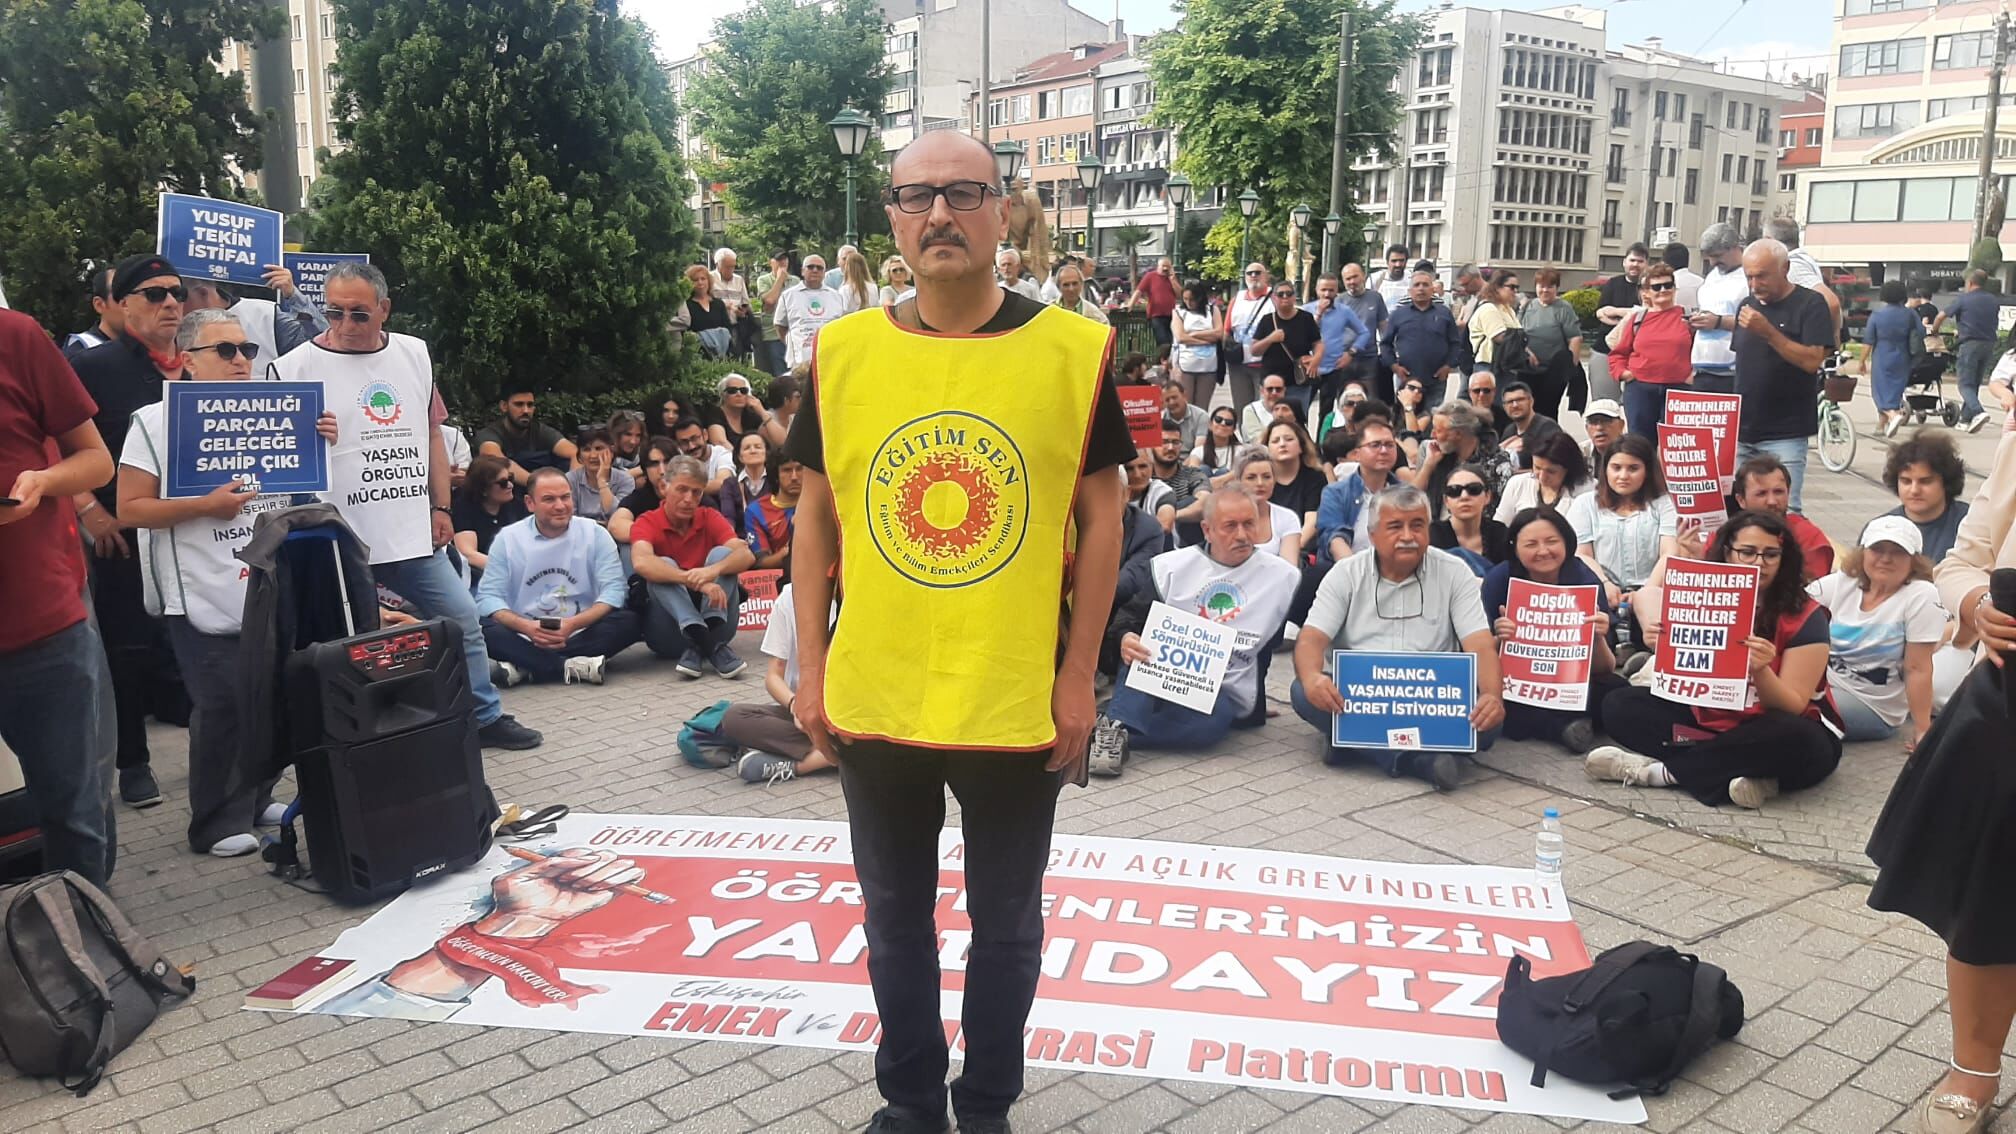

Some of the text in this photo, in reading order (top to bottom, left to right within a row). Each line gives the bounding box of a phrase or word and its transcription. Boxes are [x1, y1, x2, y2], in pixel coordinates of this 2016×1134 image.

[192, 208, 255, 230] YUSUF
[194, 226, 252, 247] TEKİN
[188, 239, 256, 265] İSTİFA!
[209, 264, 228, 275] SOL
[197, 395, 301, 414] KARANLIĞI
[1668, 399, 1736, 412] ÖĞRETMENLERE
[204, 417, 294, 435] PARÇALA
[200, 432, 296, 452] GELECEĞE
[1667, 433, 1696, 450] DÜŞÜK
[196, 452, 300, 473] SAHİP ÇIK!
[362, 446, 419, 464] YAŞASIN
[876, 425, 1020, 487] EĞİTİM SEN
[232, 473, 260, 484] SOL
[362, 462, 426, 482] ÖRGÜTLÜ
[880, 504, 1014, 576] Eğitim ve Bilim Emekçileri Sendikası
[1666, 568, 1754, 588] ÖĞRETMENLERE
[1530, 593, 1576, 611] DÜŞÜK
[1670, 588, 1740, 608] EMEKÇİLERE
[1516, 607, 1586, 625] ÜCRETLERE
[1668, 607, 1737, 624] EMEKLİLERE
[1162, 616, 1190, 634] Özel
[1192, 628, 1222, 645] Okul
[1515, 625, 1582, 642] MÜLAKATA
[1672, 626, 1724, 646] HEMEN
[1151, 629, 1224, 659] Sömürüsüne
[1506, 644, 1586, 658] GÜVENCESİZLİĞE
[1158, 644, 1210, 674] SON!
[1533, 662, 1554, 672] SON
[1677, 651, 1710, 670] ZAM
[1372, 664, 1436, 681] İNSANCA
[1348, 684, 1461, 700] YAŞANACAK BİR
[1518, 684, 1558, 702] EHP
[1668, 678, 1710, 698] EHP
[1344, 699, 1466, 717] ÜCRET İSTİYORUZ
[589, 826, 838, 853] ÖĞRETMENLER
[1047, 848, 1553, 910] ÇİN AÇLIK GREVİNDELER!
[671, 980, 808, 1002] Eskişehir
[644, 1001, 792, 1037] EMEK
[796, 1013, 837, 1034] Ve
[1188, 1038, 1508, 1102] Platformu
